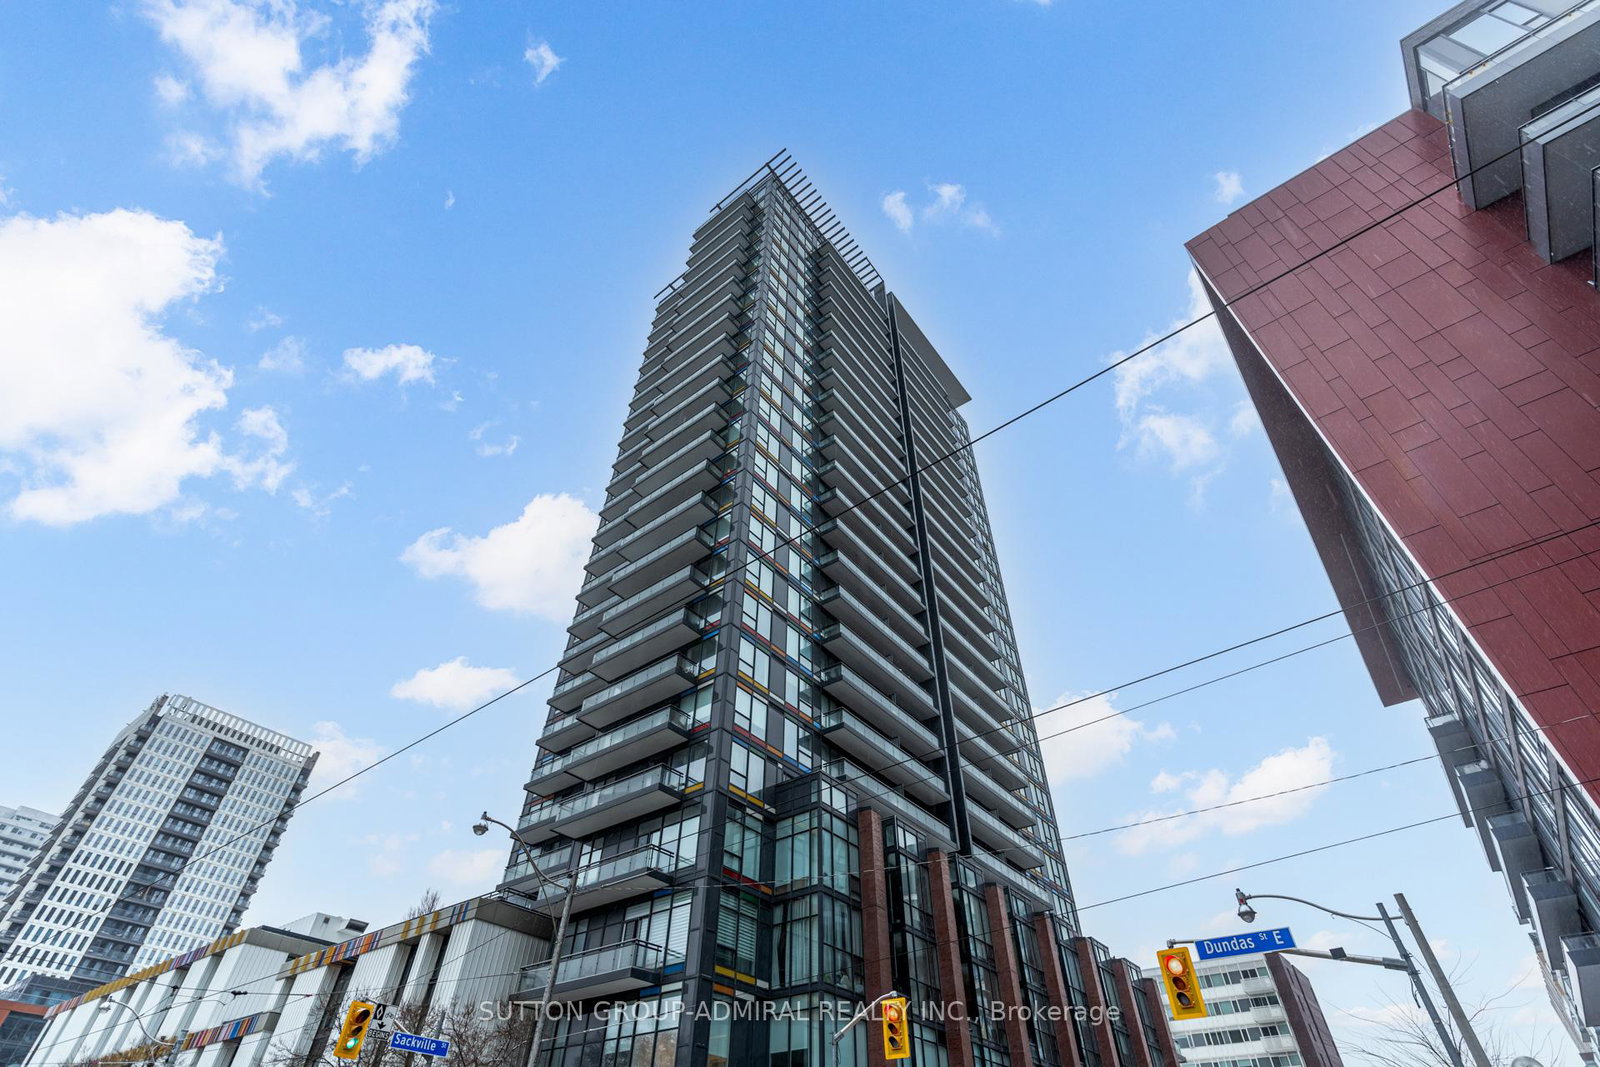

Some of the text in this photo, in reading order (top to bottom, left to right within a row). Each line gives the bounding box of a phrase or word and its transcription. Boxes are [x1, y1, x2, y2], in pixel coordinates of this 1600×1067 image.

[1203, 930, 1284, 954] Dundas St E
[367, 1029, 390, 1040] BEGINS
[394, 1033, 437, 1051] Sackville
